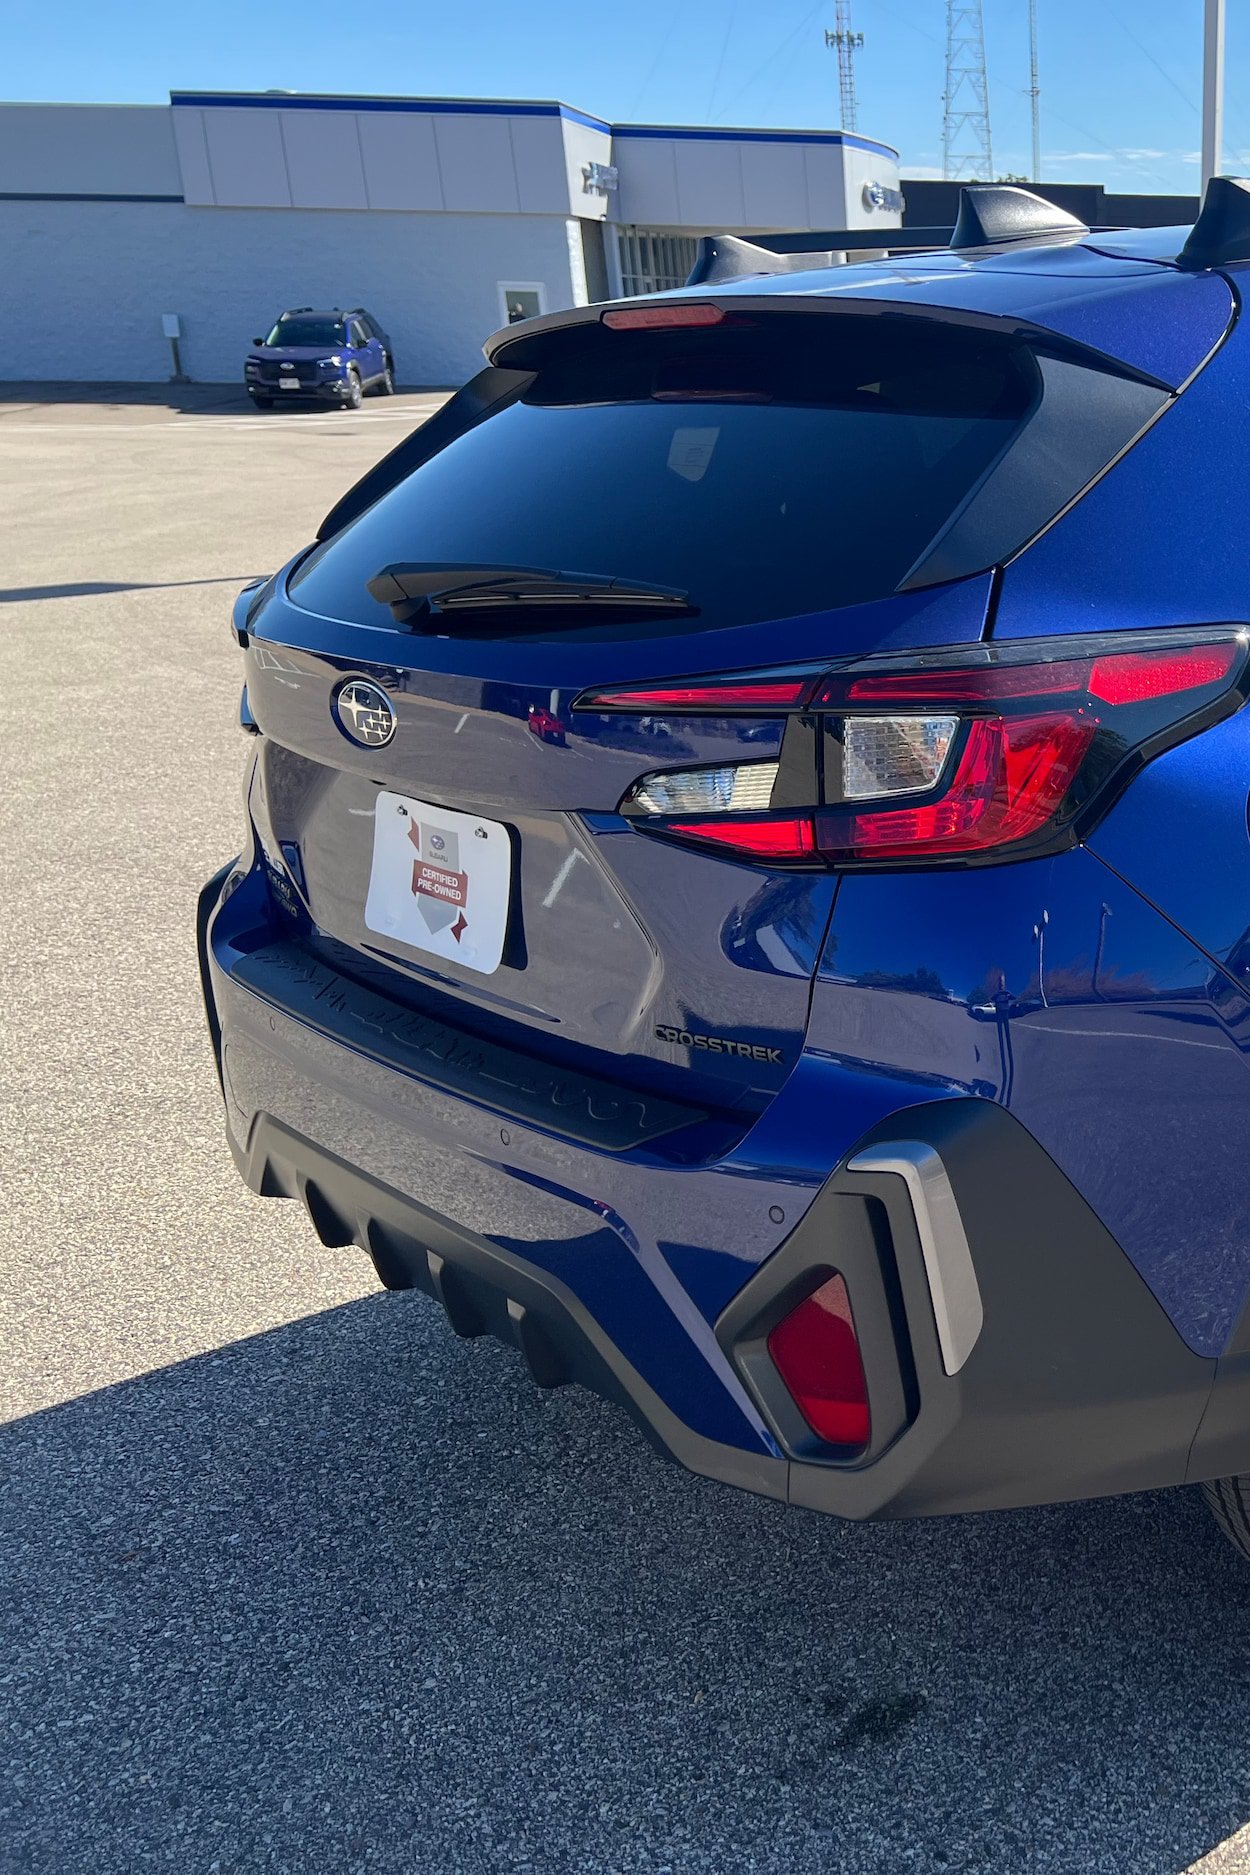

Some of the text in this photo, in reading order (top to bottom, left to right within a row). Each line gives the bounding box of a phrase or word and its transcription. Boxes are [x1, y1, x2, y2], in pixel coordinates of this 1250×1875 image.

[422, 867, 459, 887] CERTIFIED
[418, 879, 462, 900] PRE-OWNED
[654, 1025, 784, 1064] CROSSTREK
